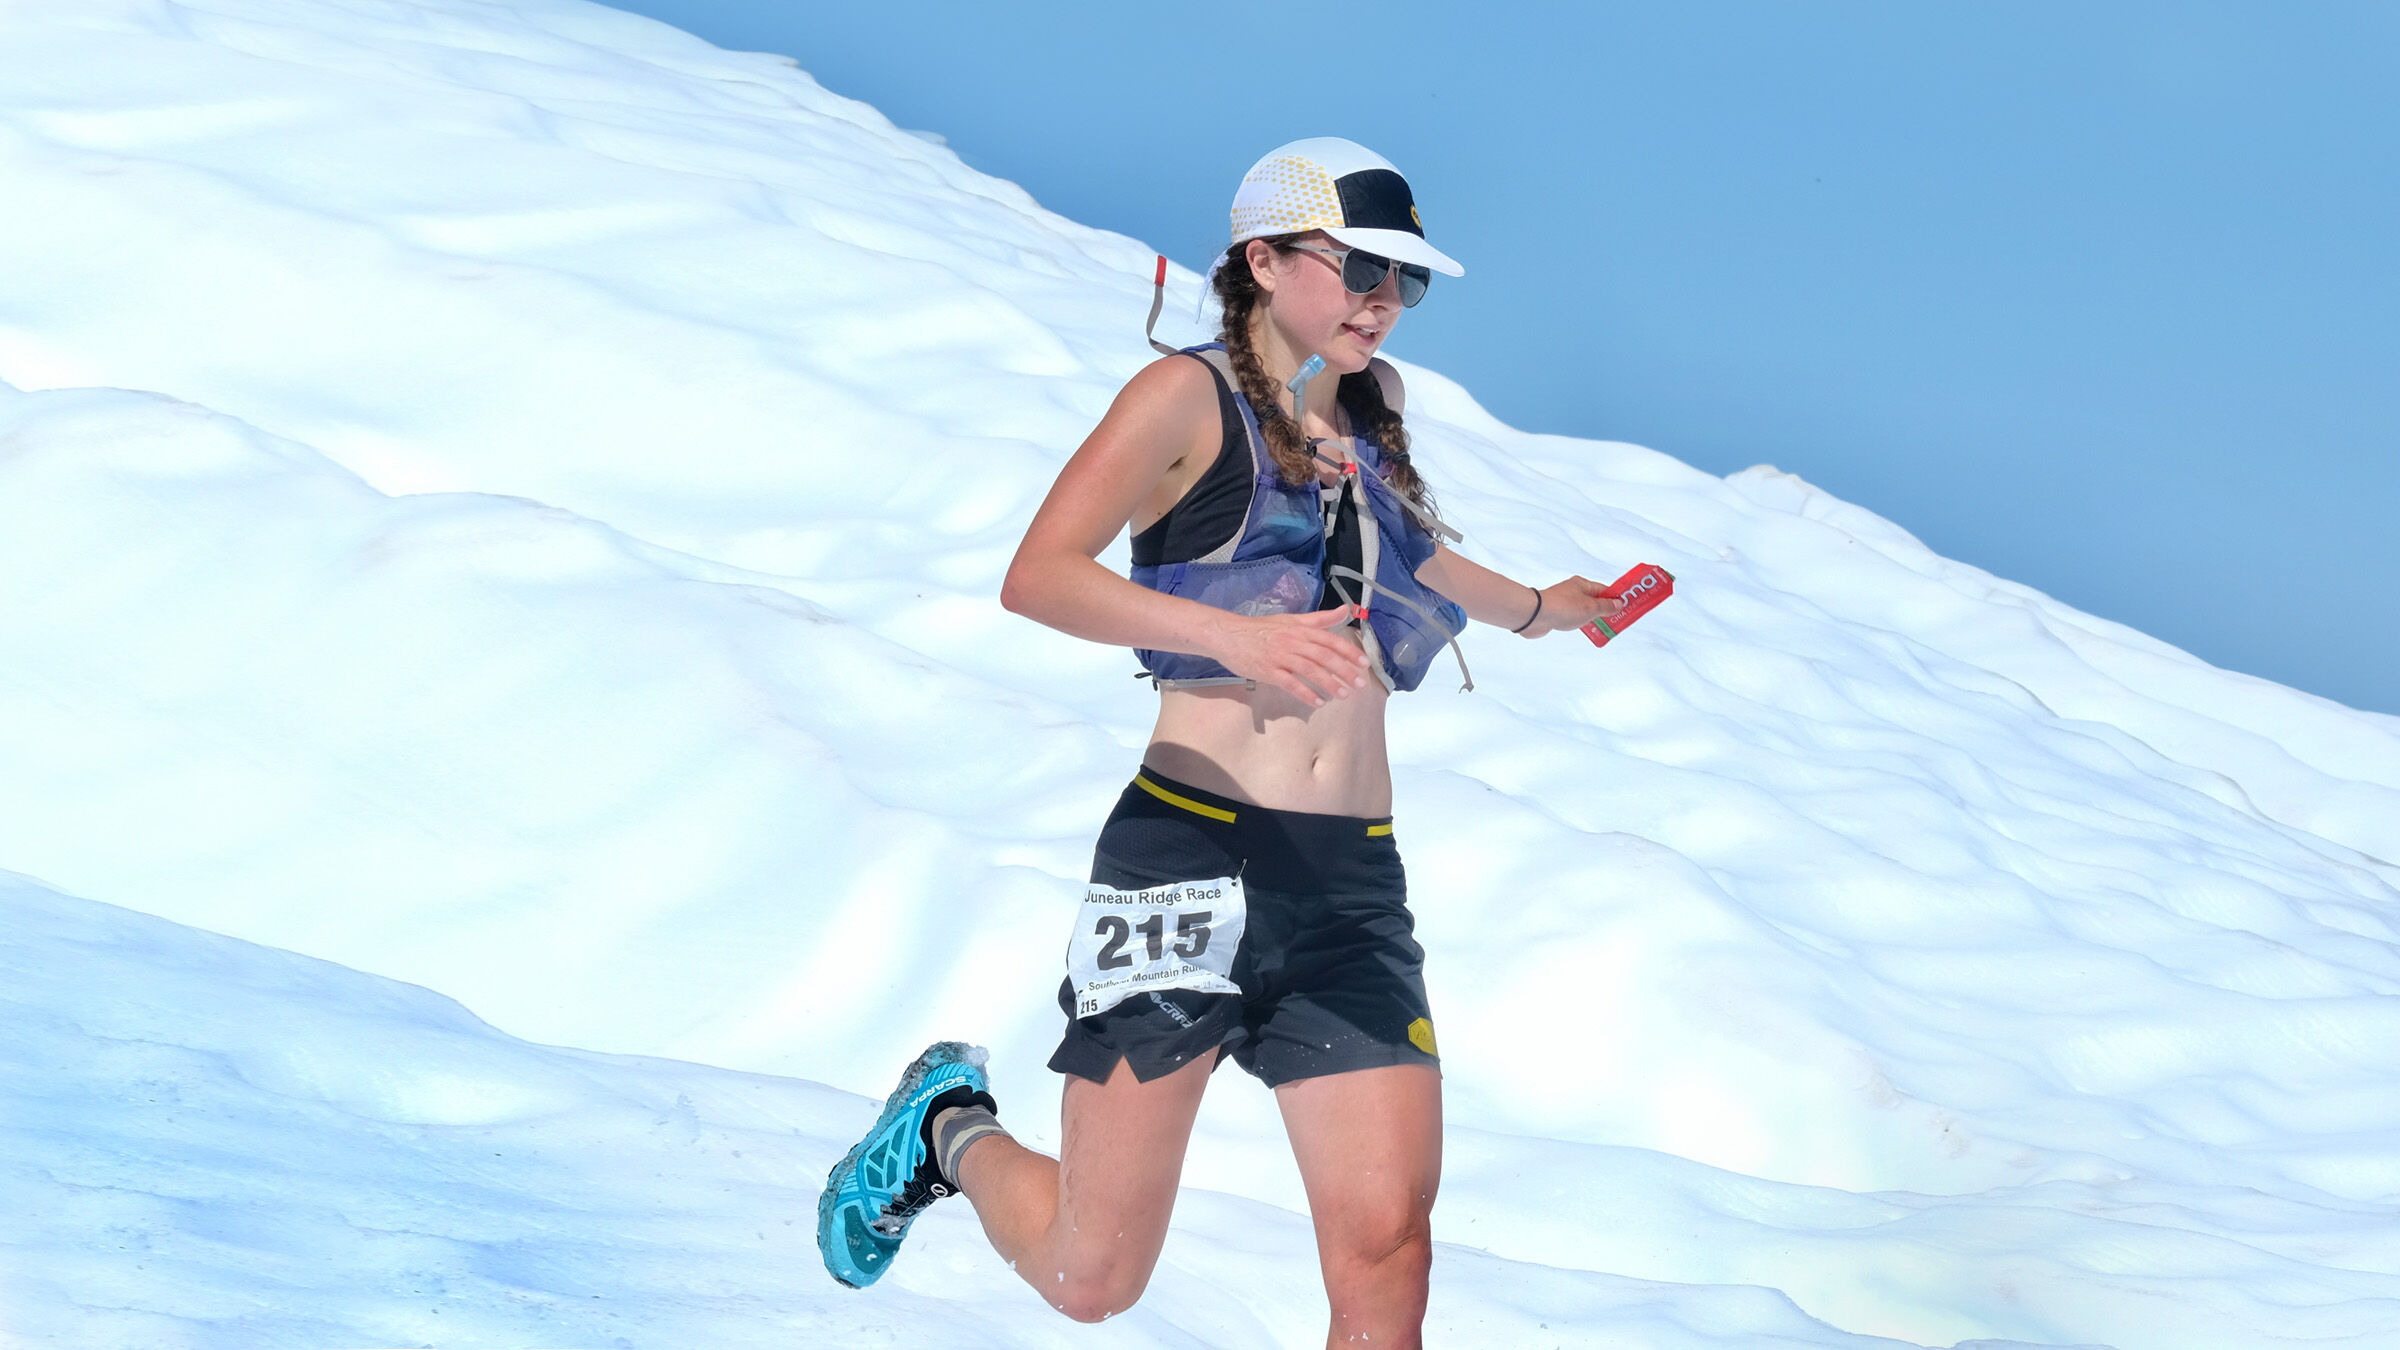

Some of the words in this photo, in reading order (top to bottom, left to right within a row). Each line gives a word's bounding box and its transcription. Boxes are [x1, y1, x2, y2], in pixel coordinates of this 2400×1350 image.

[1085, 889, 1133, 904] Juneau
[1139, 891, 1182, 906] Ridge
[1186, 888, 1222, 901] Race
[1094, 911, 1213, 971] 215
[1132, 968, 1179, 982] Mountain
[1080, 999, 1098, 1014] 215
[1160, 1002, 1193, 1029] CRAZ
[909, 1075, 967, 1108] SCARPA
